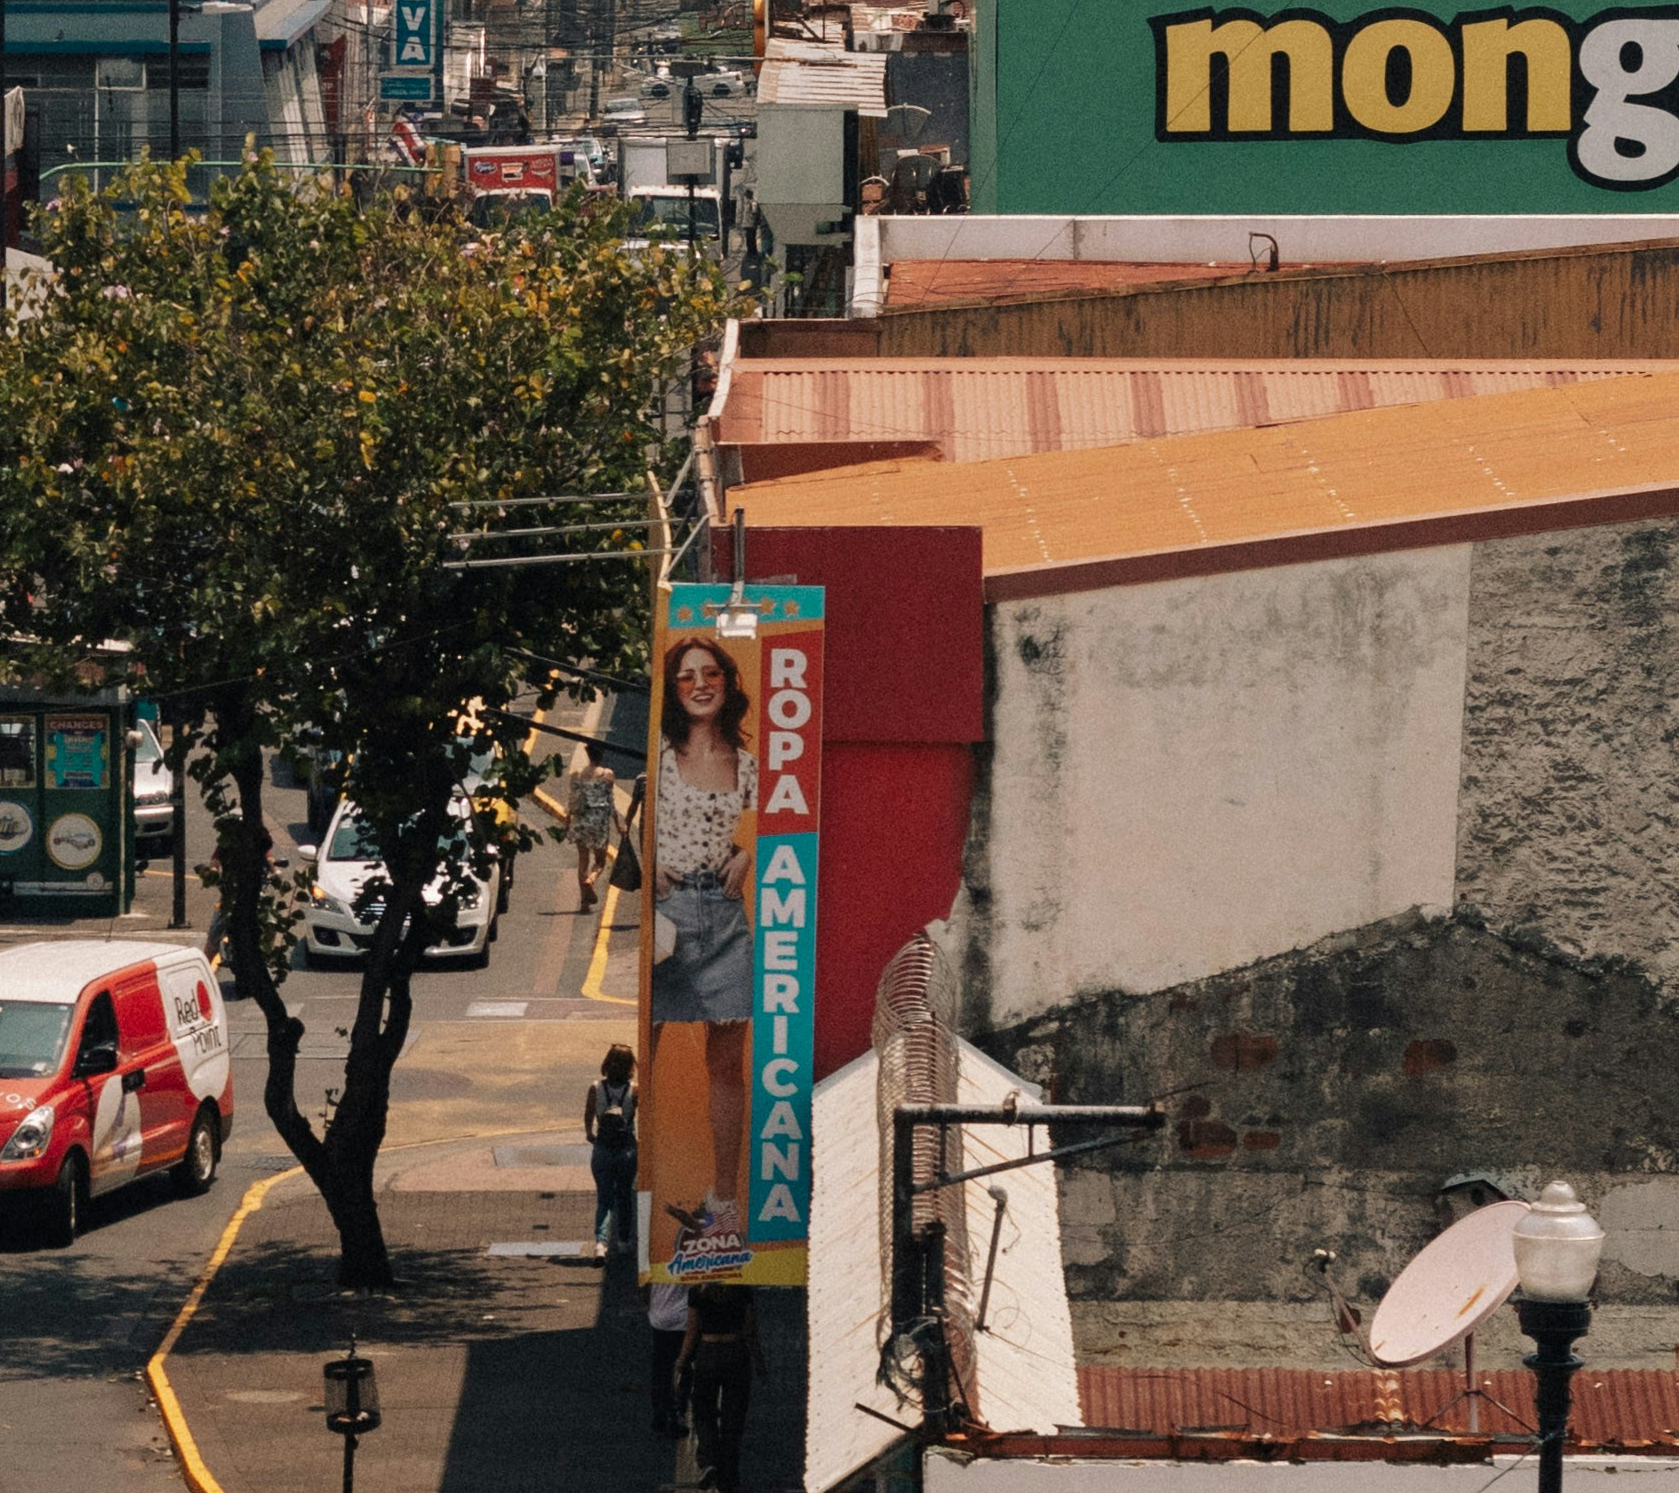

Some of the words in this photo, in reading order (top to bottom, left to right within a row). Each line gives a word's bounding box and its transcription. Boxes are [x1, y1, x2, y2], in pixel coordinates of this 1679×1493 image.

[49, 720, 104, 730] CHANGES
[767, 648, 810, 816] ROPA
[174, 989, 199, 1026] Red
[757, 844, 808, 1223] AMERICANA
[683, 1234, 741, 1254] ZONA
[667, 1251, 753, 1276] Americana
